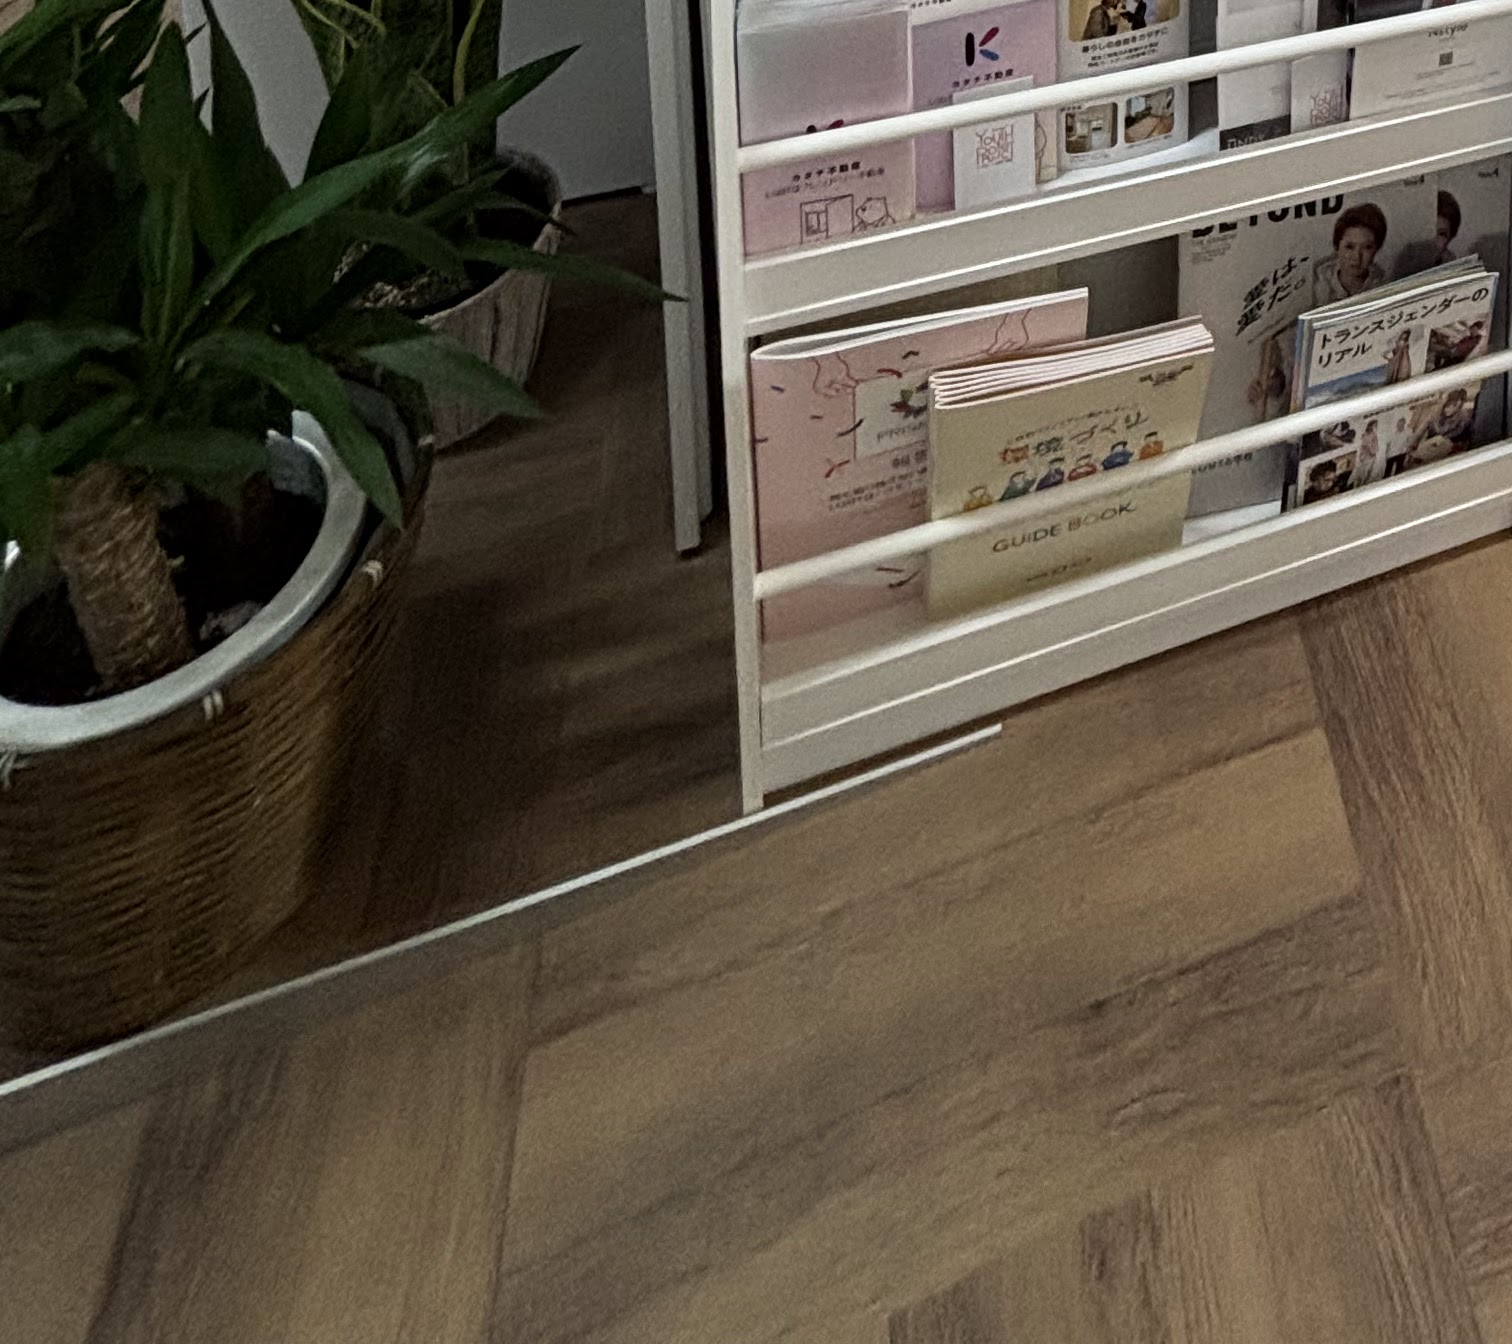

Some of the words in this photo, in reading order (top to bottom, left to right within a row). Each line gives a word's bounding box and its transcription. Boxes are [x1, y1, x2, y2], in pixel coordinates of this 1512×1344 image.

[792, 161, 861, 183] カタチ不動産
[1320, 288, 1490, 351] トランスジェンダーの
[1318, 342, 1374, 368] リアル
[992, 526, 1062, 553] GUIDE
[1067, 501, 1137, 532] BOOK
